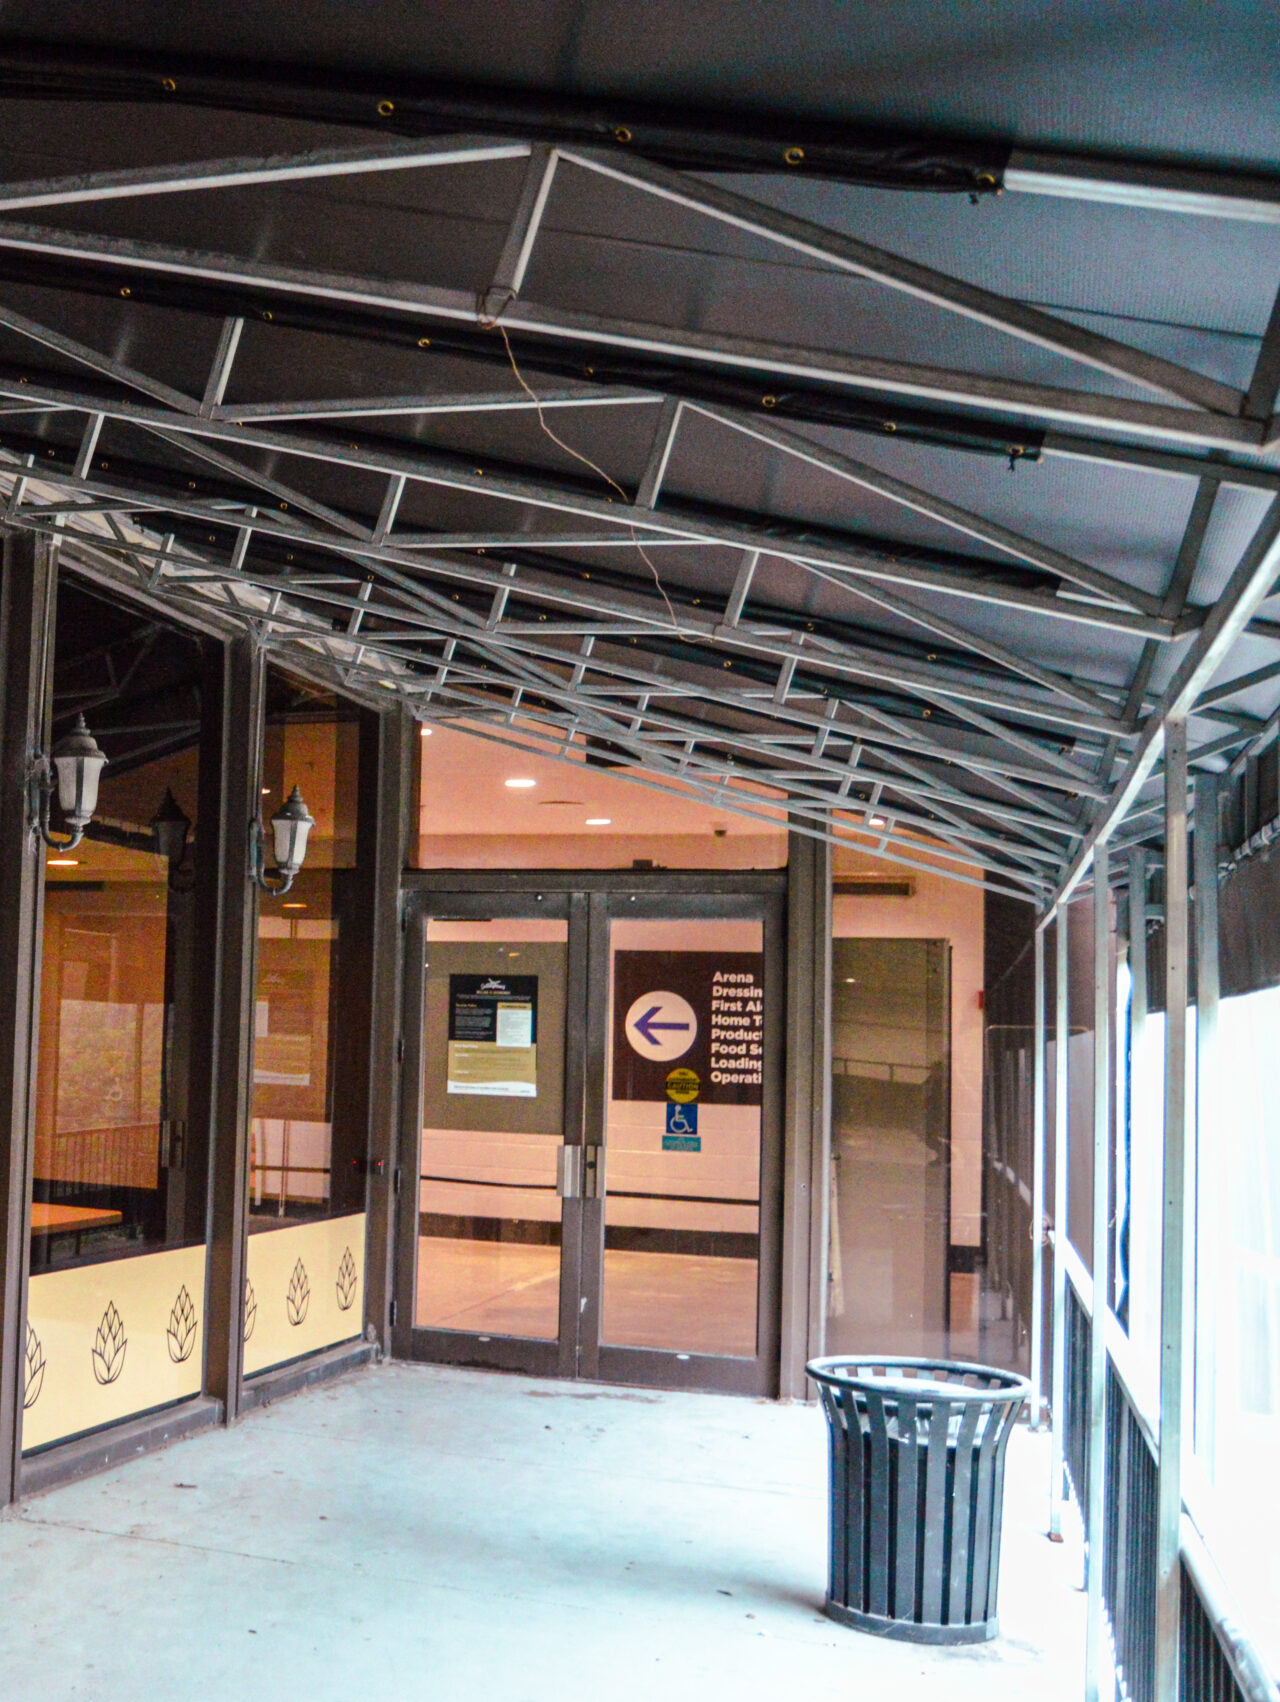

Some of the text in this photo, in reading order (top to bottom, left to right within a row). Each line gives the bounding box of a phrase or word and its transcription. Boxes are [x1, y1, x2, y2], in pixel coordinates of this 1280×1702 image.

[713, 971, 754, 983] Arena
[712, 985, 763, 998] Dressin
[711, 999, 762, 1012] First Ai
[711, 1014, 751, 1026] Home
[711, 1042, 746, 1055] Food
[710, 1071, 762, 1085] Operati
